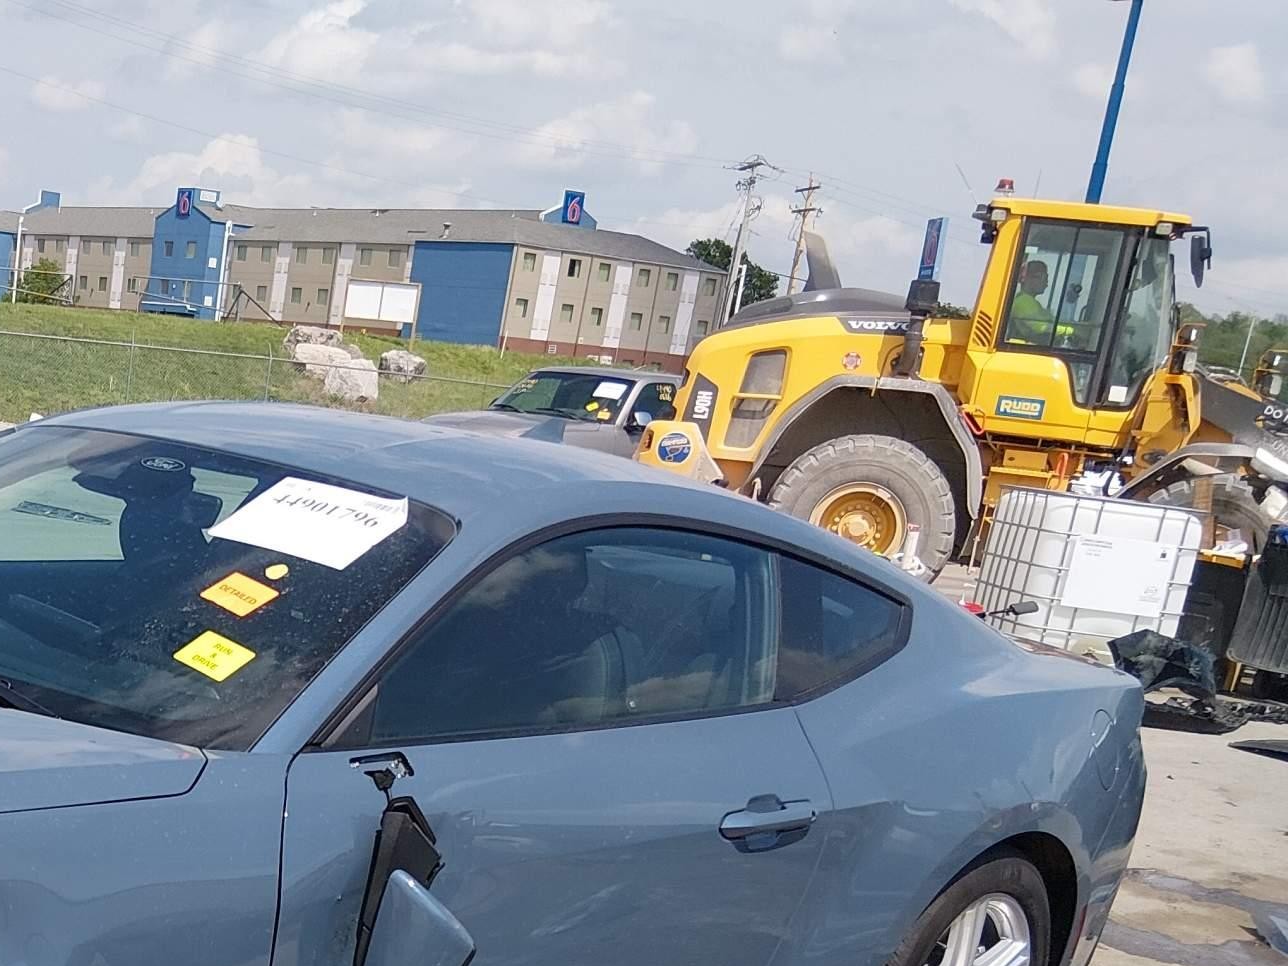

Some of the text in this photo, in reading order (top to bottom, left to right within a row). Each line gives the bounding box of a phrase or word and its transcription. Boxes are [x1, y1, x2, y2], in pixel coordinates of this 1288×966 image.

[567, 196, 581, 222] 6
[848, 320, 911, 331] VOLVO
[692, 390, 713, 419] L90H
[999, 399, 1041, 413] RUDD
[218, 584, 257, 605] DETAILED
[213, 643, 233, 655] RUN
[192, 654, 218, 671] DRIVE
